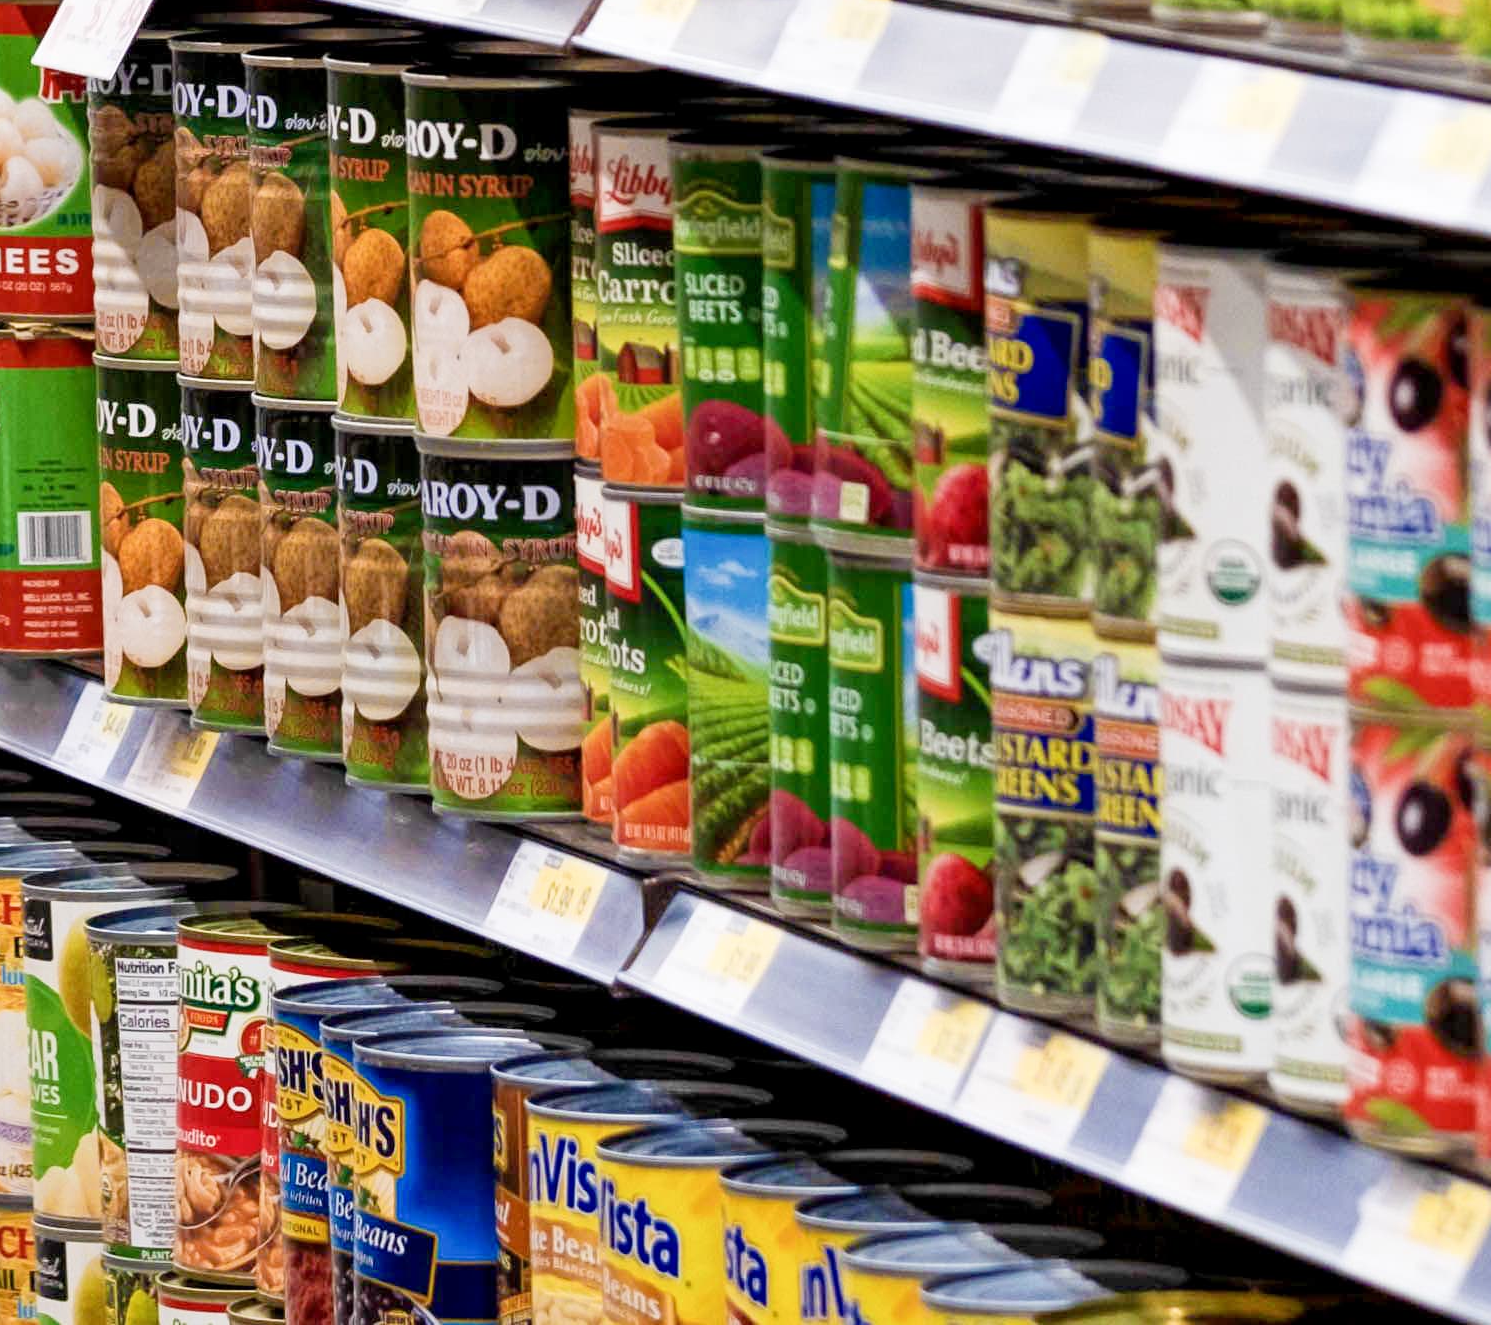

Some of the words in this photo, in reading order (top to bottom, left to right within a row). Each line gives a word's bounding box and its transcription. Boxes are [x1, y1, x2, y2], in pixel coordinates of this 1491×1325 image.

[406, 117, 518, 162] ROY-D
[684, 271, 746, 298] SLICED
[688, 300, 743, 325] BEETS
[117, 960, 165, 976] Nutrition
[178, 961, 256, 1006] nita's
[119, 1015, 170, 1029] Calories
[179, 1075, 253, 1112] NUDO
